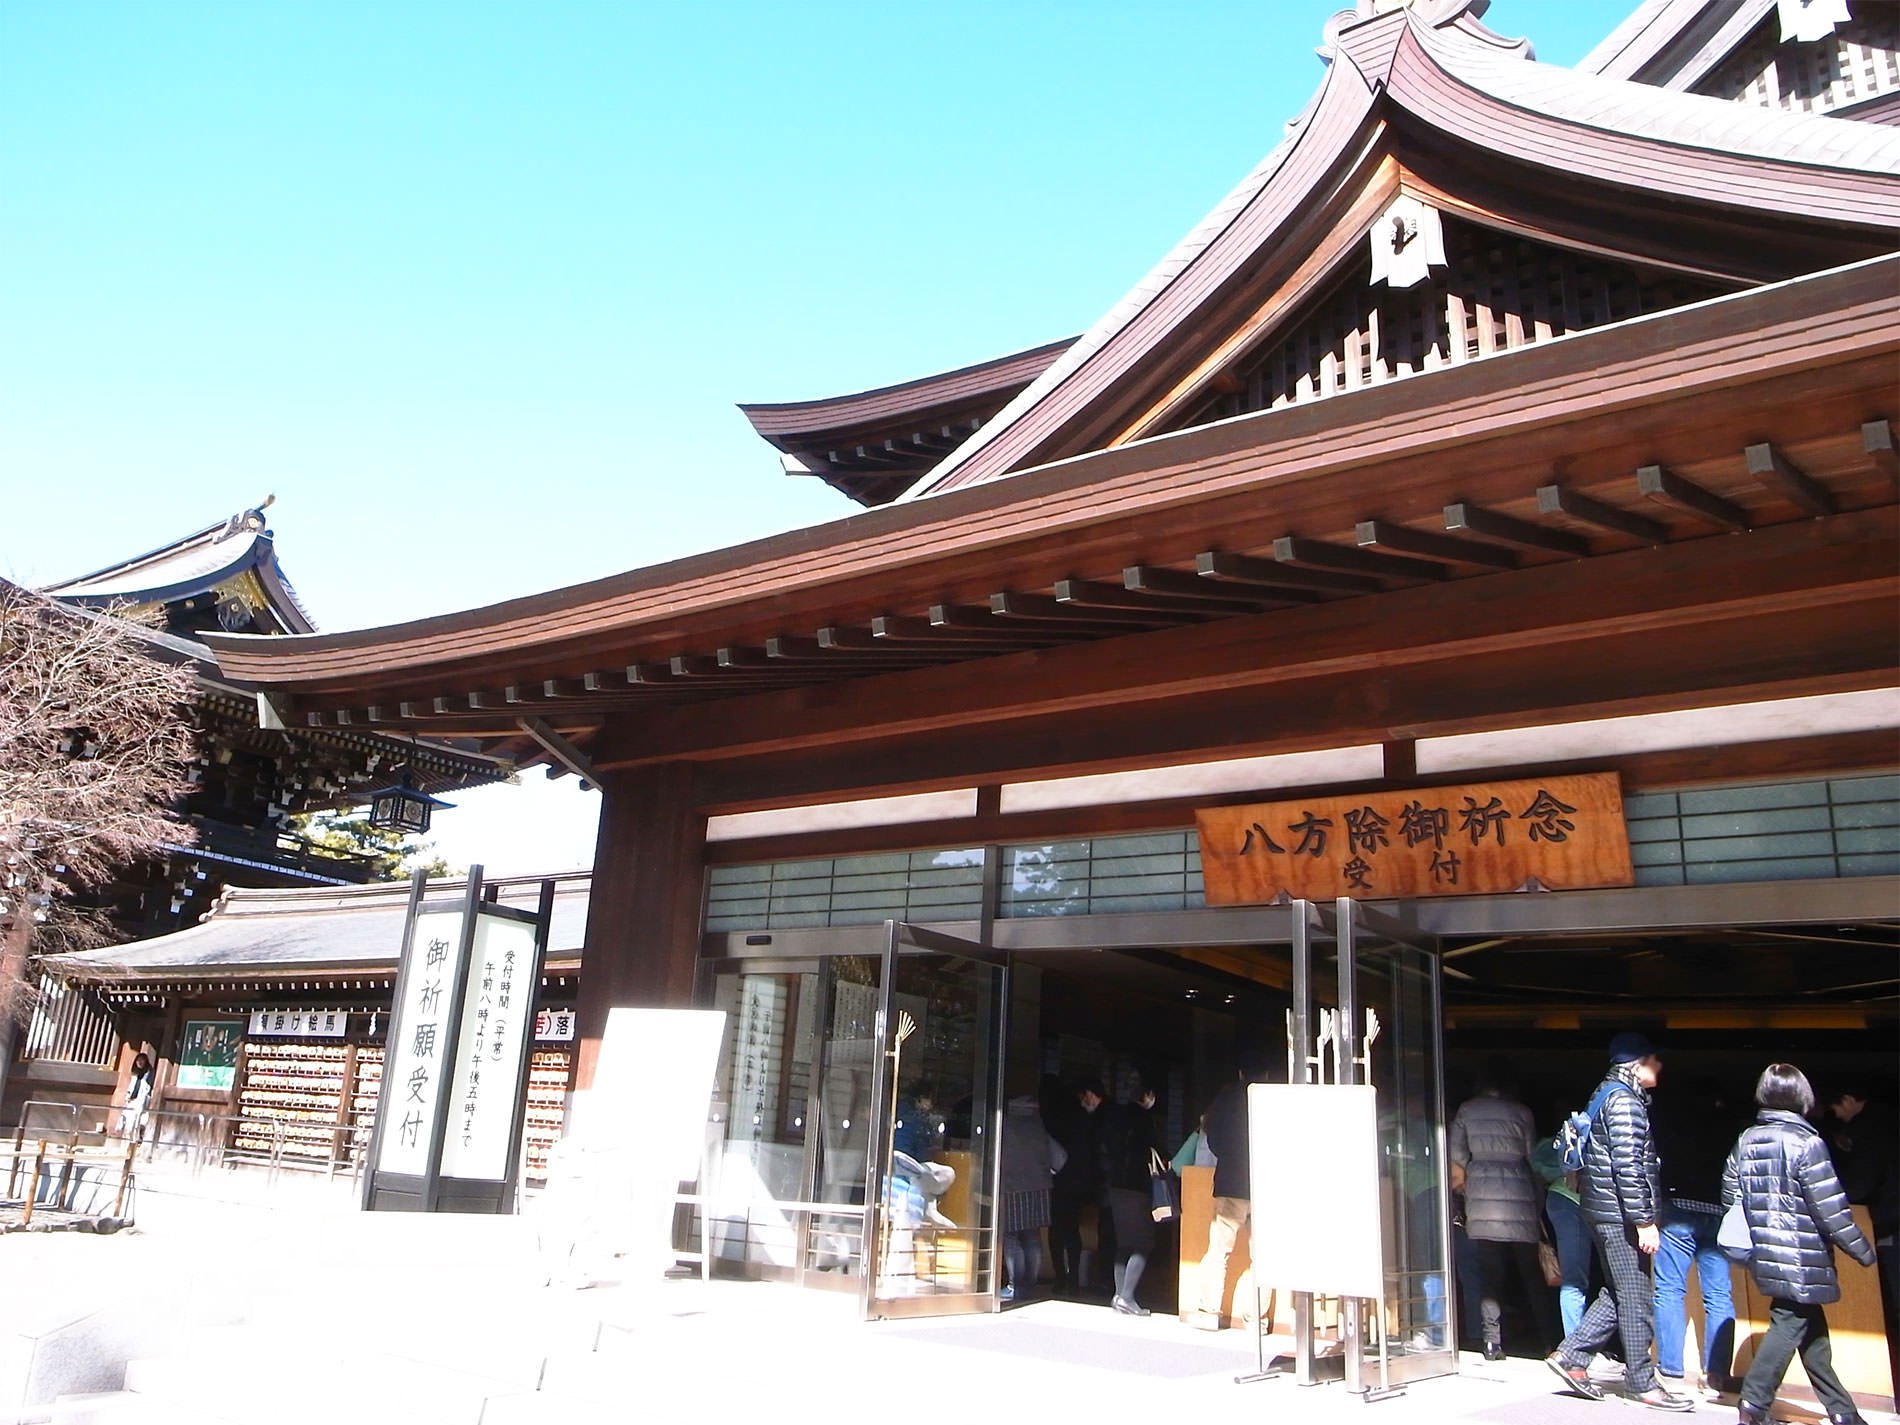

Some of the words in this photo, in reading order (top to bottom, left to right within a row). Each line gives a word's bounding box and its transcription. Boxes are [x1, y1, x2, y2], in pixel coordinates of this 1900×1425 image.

[1240, 788, 1578, 857] 八方除御祈念
[1343, 849, 1462, 890] 受付
[400, 936, 450, 1150] 御祈願受付
[462, 961, 496, 1149] 午前八時より午後五時まで
